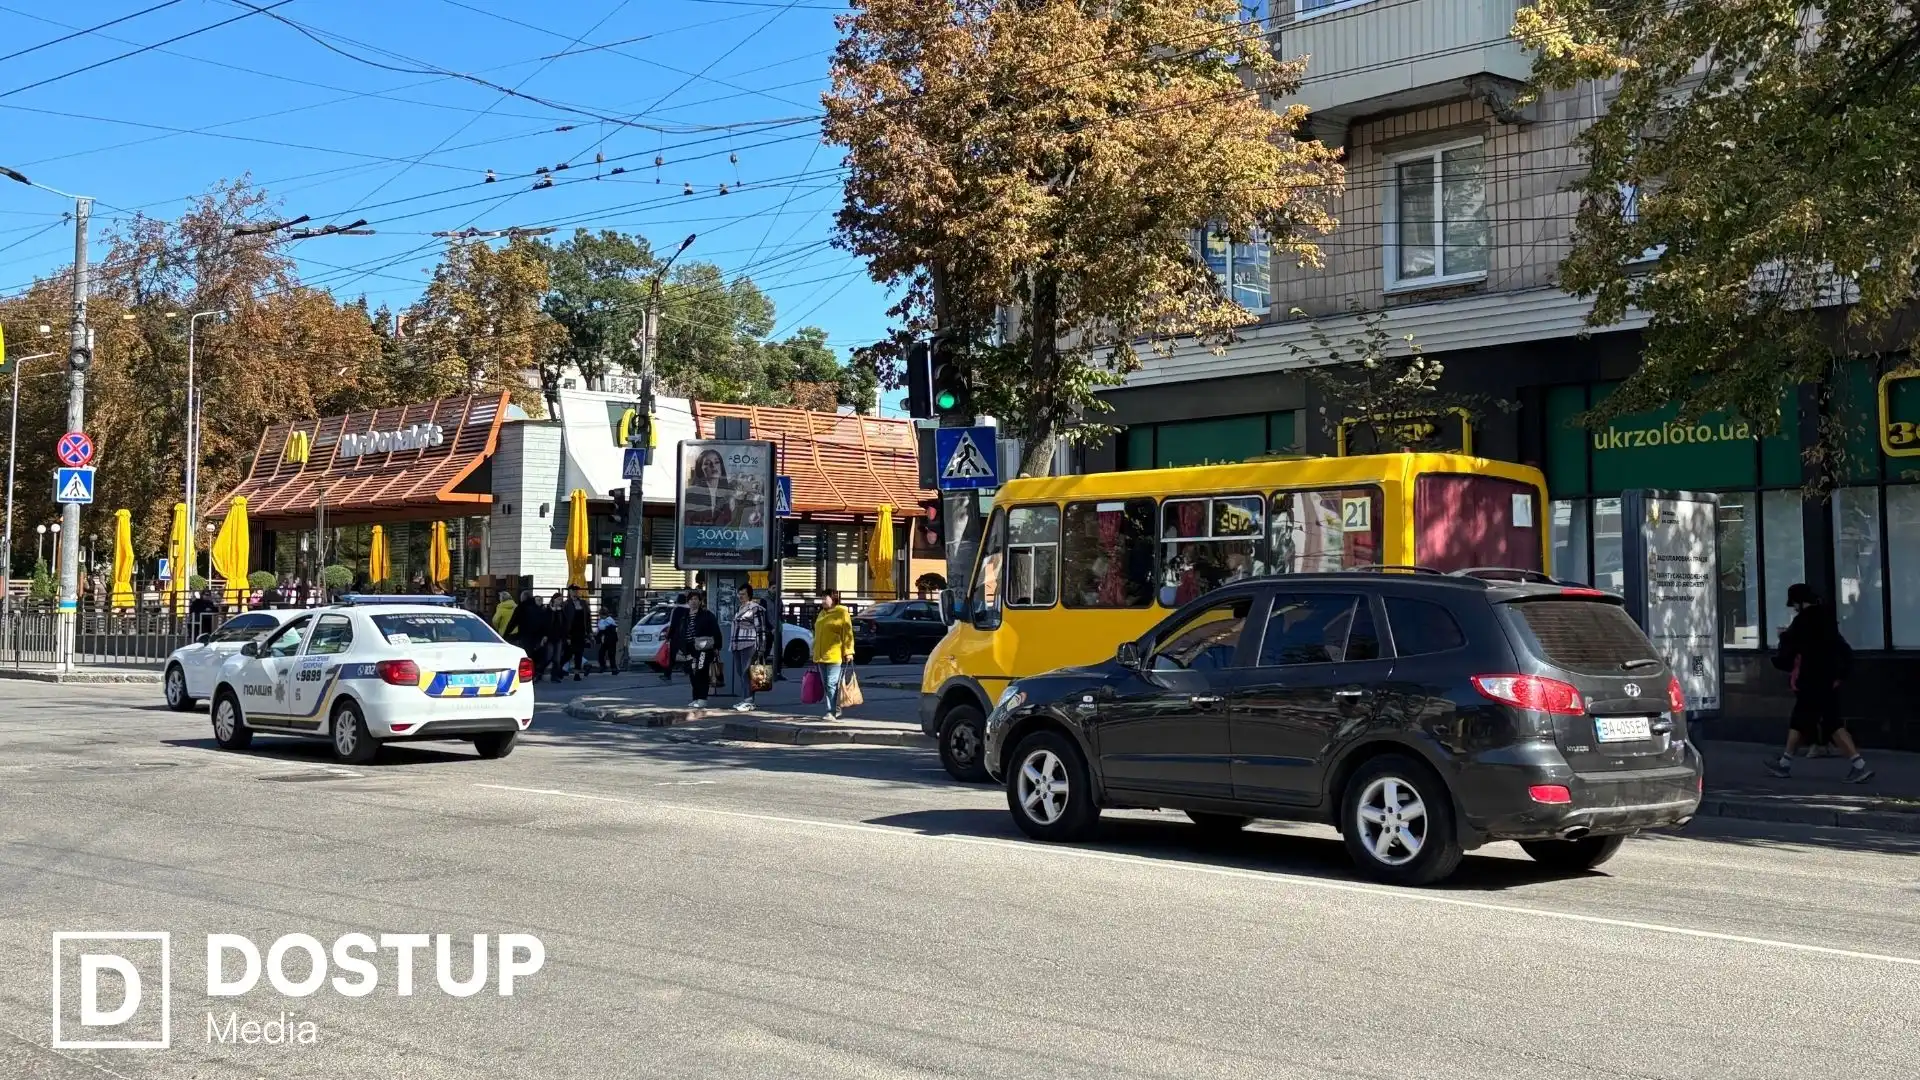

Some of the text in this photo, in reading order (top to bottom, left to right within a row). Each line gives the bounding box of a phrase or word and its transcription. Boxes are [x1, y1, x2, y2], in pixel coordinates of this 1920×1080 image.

[1594, 421, 1750, 450] ukrzoloto.ua
[1344, 501, 1369, 528] 21
[696, 528, 750, 541] ЗОЛОТА
